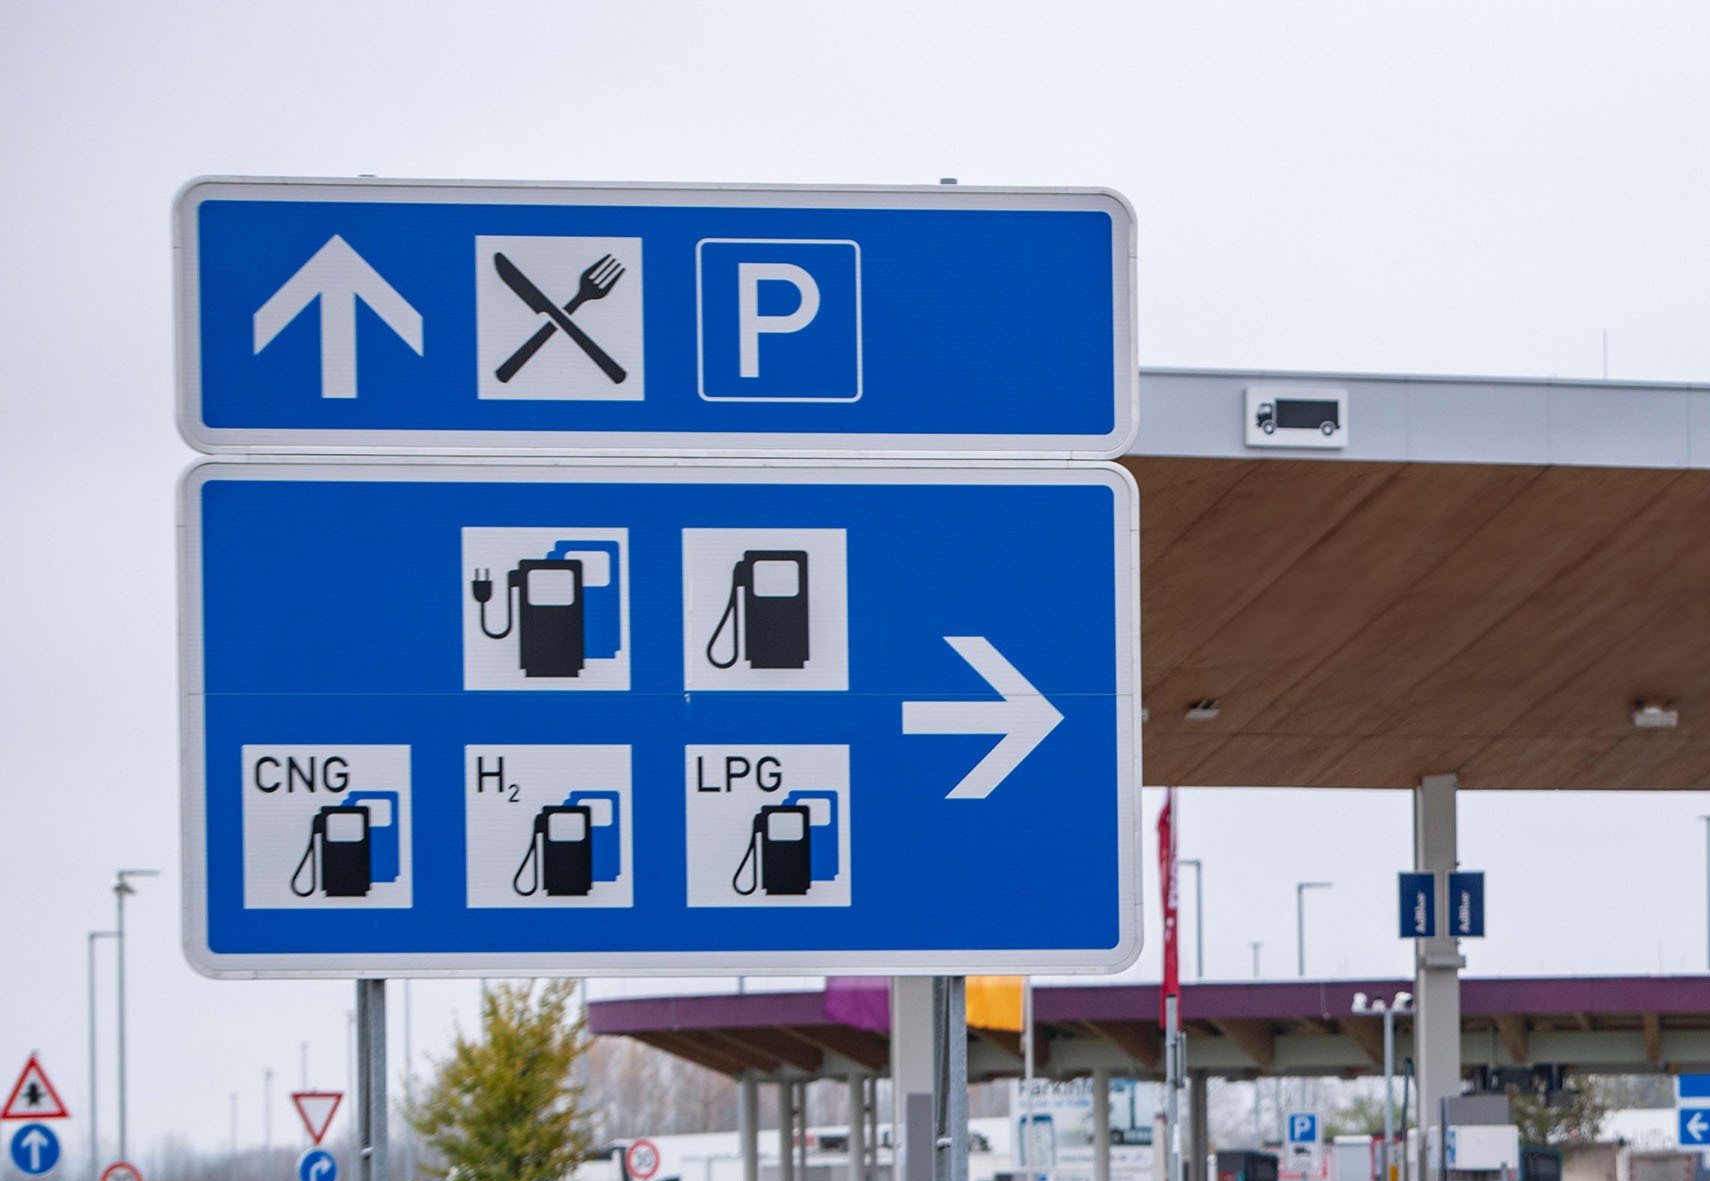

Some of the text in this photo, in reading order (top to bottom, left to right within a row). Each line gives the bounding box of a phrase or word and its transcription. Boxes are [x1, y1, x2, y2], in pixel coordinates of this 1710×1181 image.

[738, 262, 820, 378] P
[254, 756, 350, 793] CNG
[696, 756, 783, 793] LPG
[1414, 890, 1426, 934] AdBlue
[1458, 889, 1470, 933] AdBlue
[1293, 1116, 1312, 1141] P
